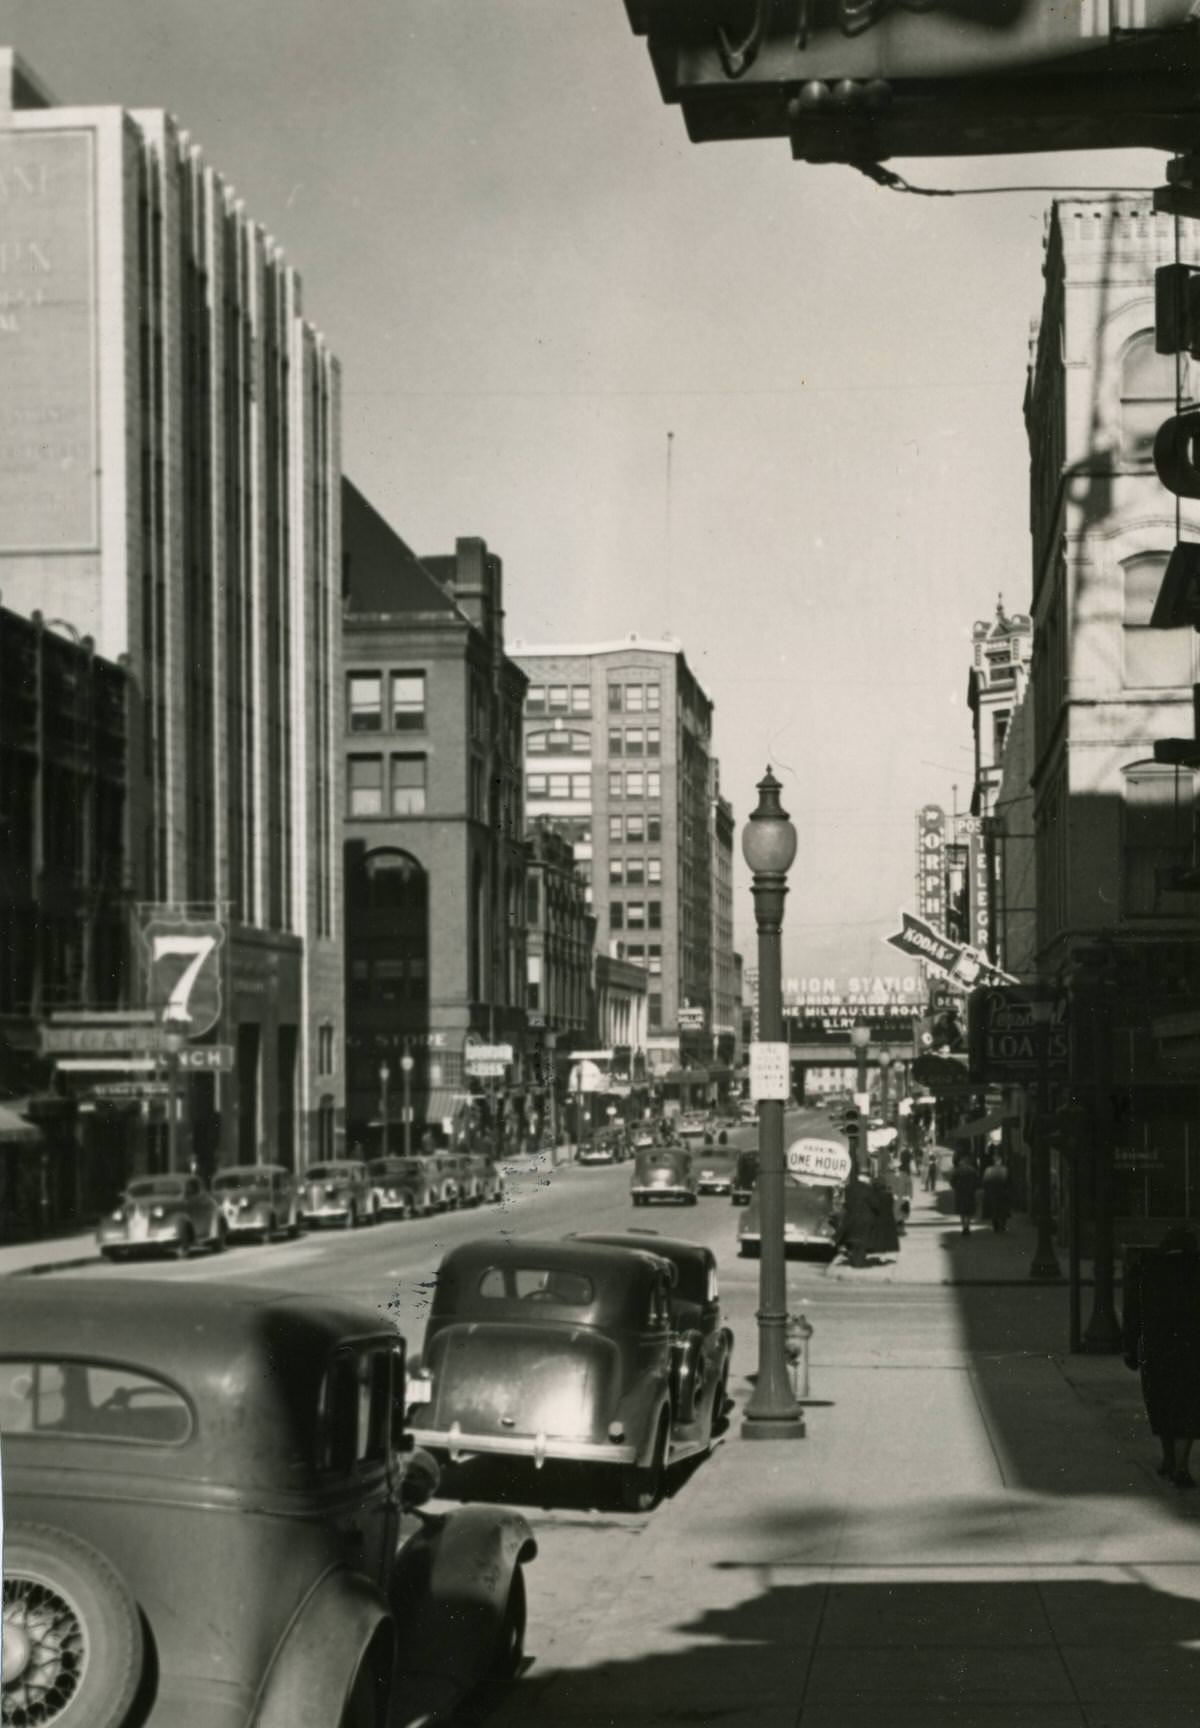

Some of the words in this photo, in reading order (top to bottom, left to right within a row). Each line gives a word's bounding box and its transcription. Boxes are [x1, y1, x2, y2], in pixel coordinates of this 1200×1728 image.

[903, 928, 948, 960] KODAK
[153, 935, 217, 1022] 7
[781, 977, 835, 992] NION
[781, 1006, 799, 1017] HE
[790, 1153, 811, 1168] ONE
[815, 1156, 847, 1171] HOUR
